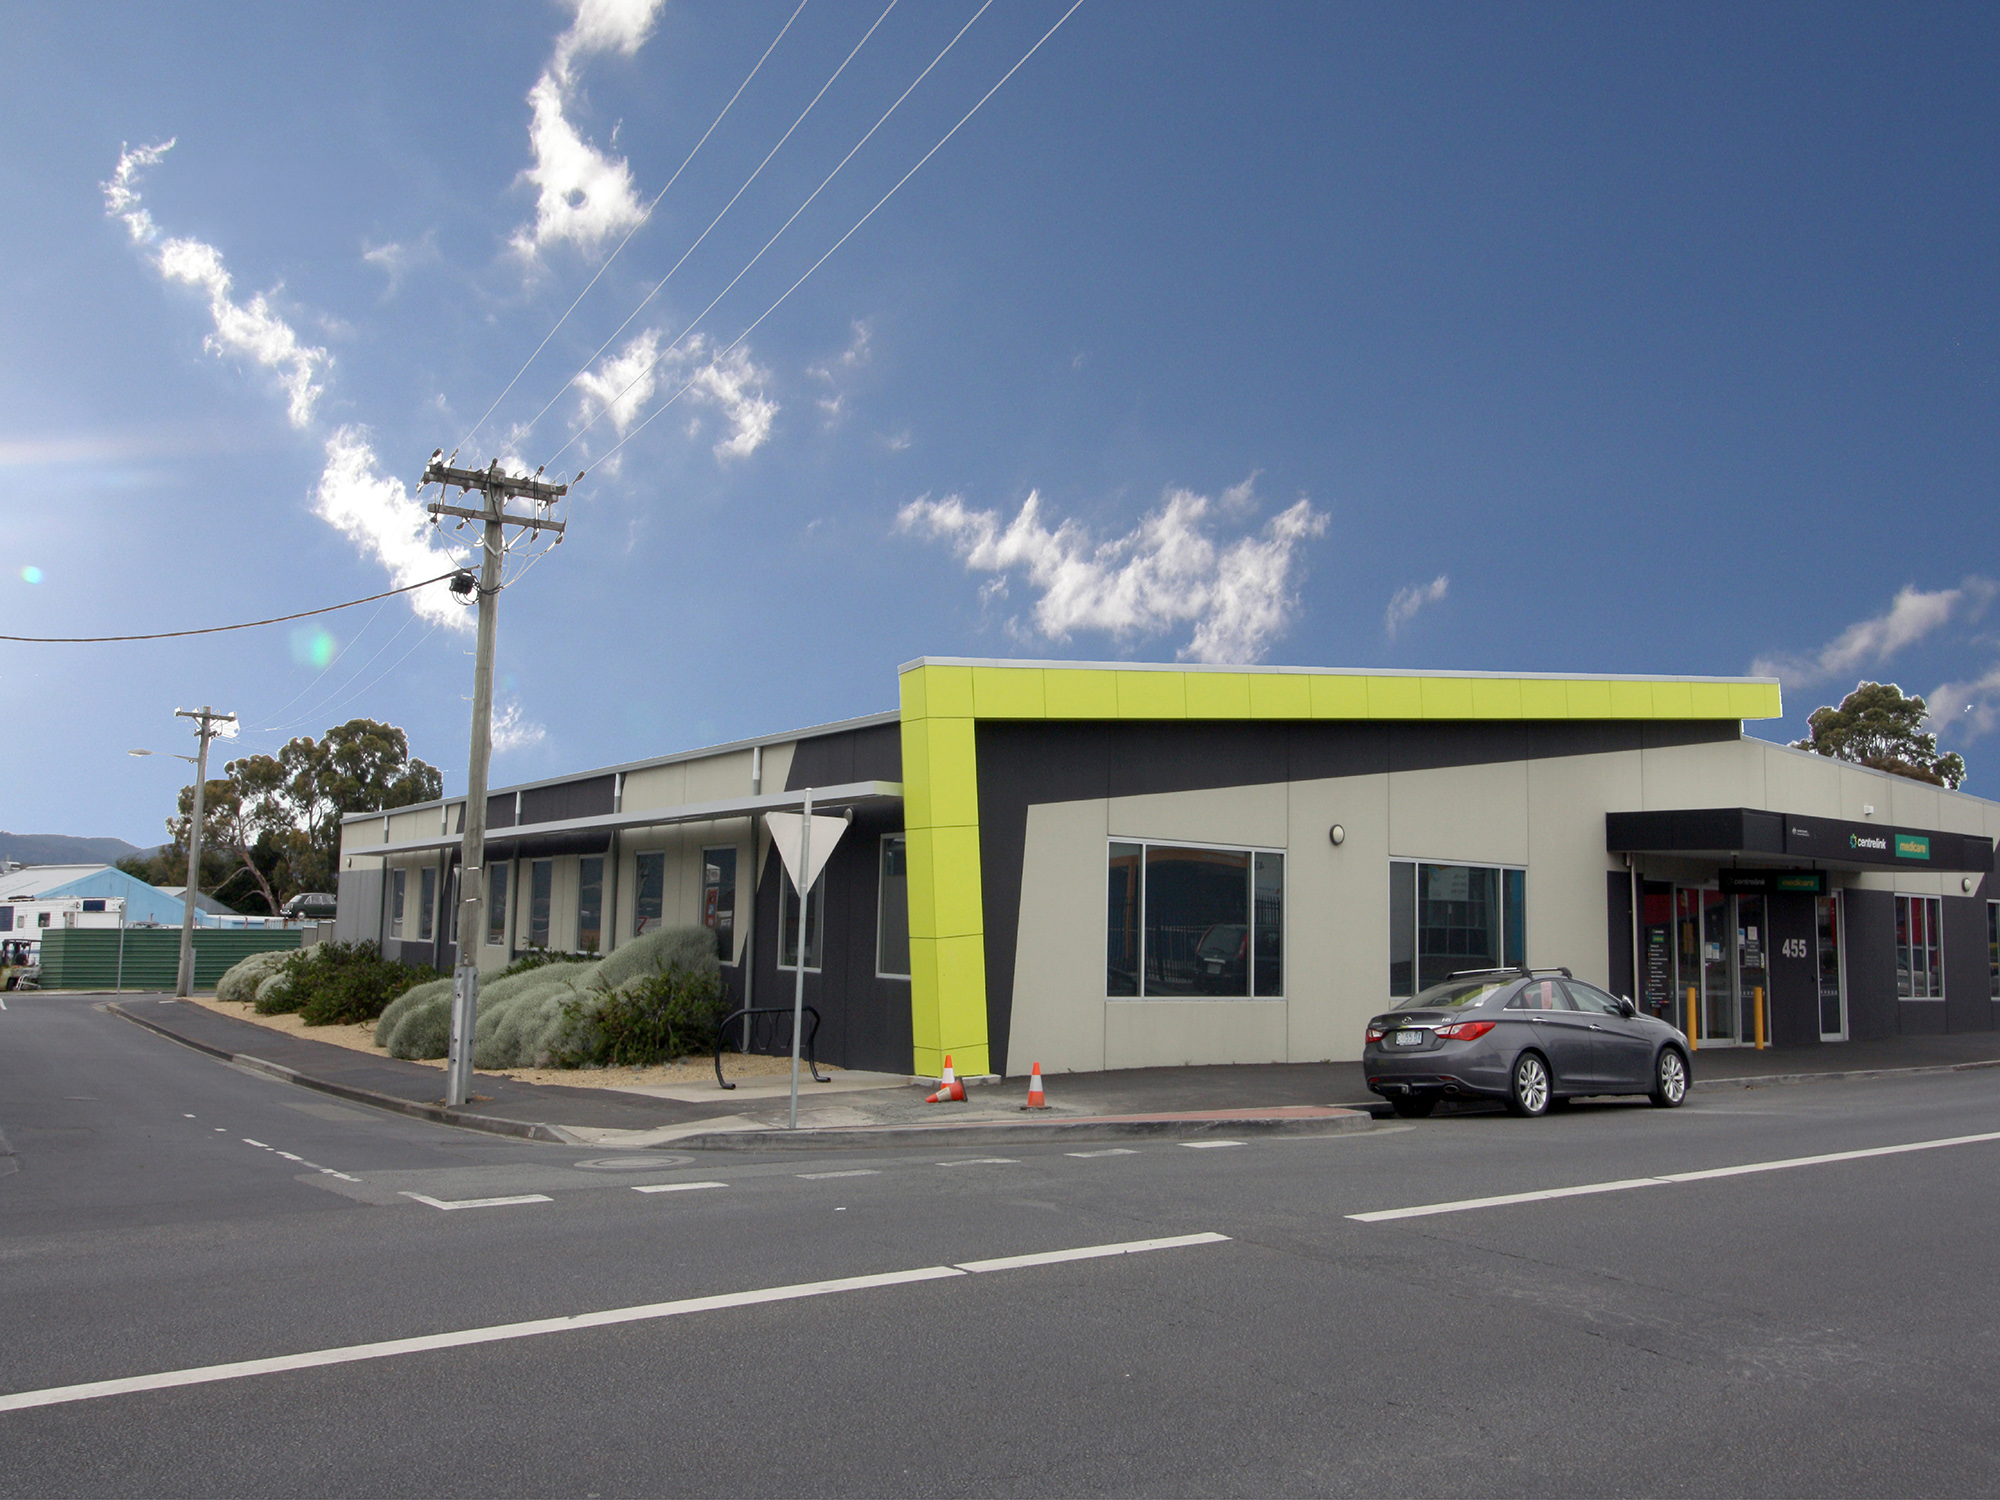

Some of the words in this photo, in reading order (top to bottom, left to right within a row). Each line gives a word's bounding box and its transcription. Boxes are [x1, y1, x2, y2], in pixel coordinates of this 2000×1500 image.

[1857, 837, 1887, 850] centrelink
[1899, 841, 1927, 853] medicare
[1733, 878, 1766, 886] centrelink
[1782, 878, 1815, 887] medicare
[1782, 938, 1807, 958] 455
